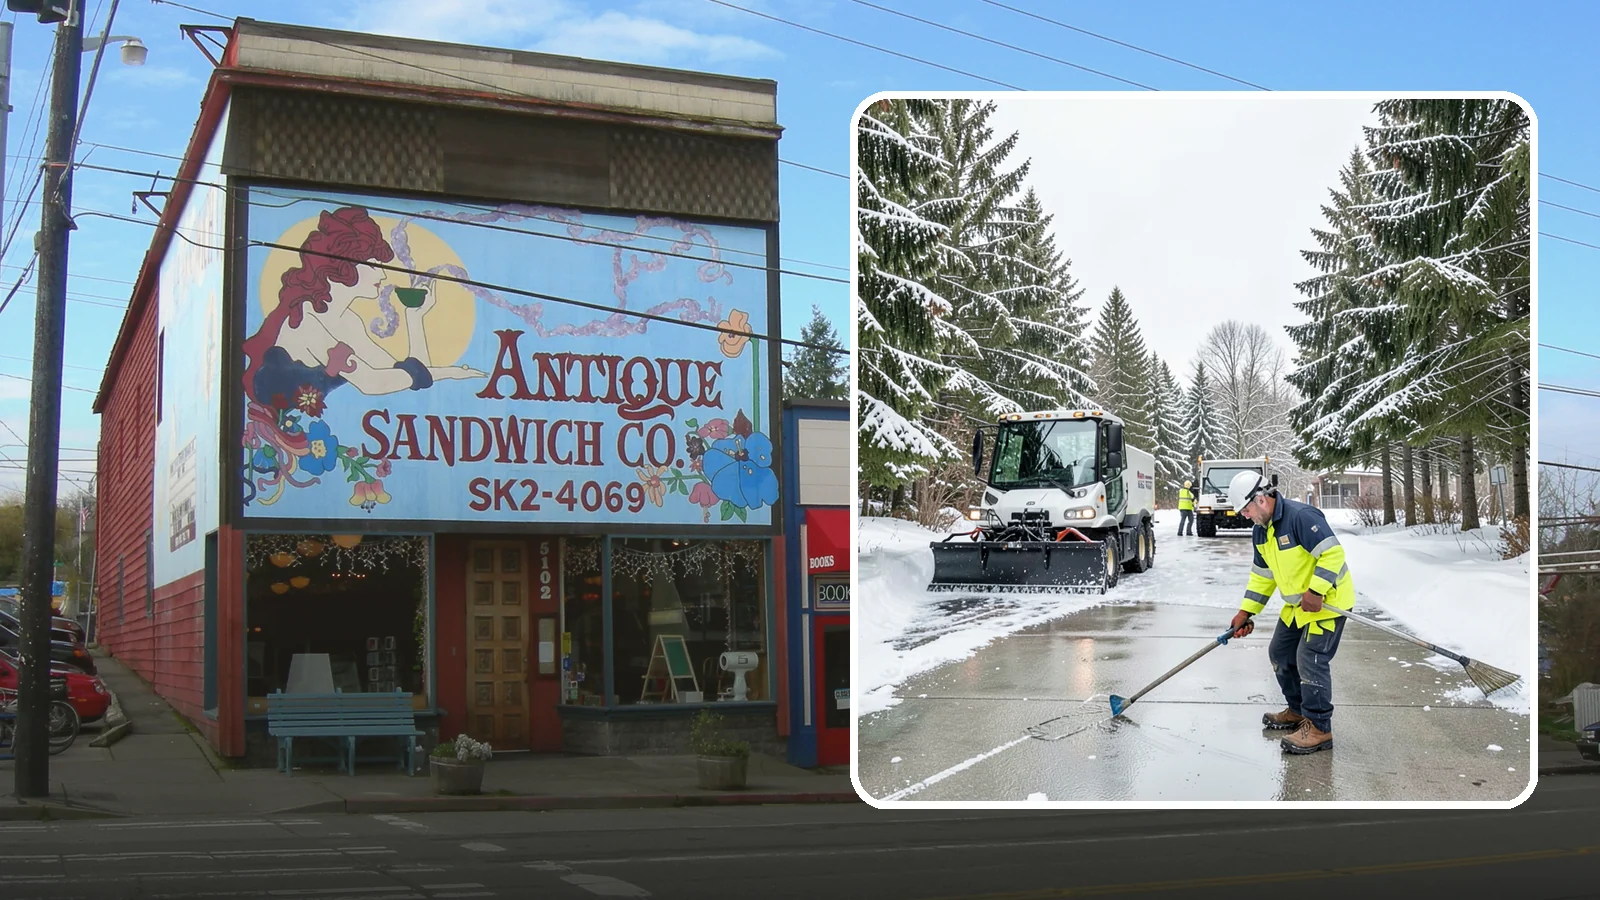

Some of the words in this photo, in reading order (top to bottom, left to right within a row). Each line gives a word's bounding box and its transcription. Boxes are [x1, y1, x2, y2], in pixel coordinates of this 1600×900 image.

[476, 329, 723, 421] ANTIQUE
[361, 409, 605, 467] SANDWICH
[617, 422, 686, 469] CO.
[469, 477, 646, 512] SK2-4069
[540, 542, 551, 599] 5102
[809, 555, 835, 569] BOOKS
